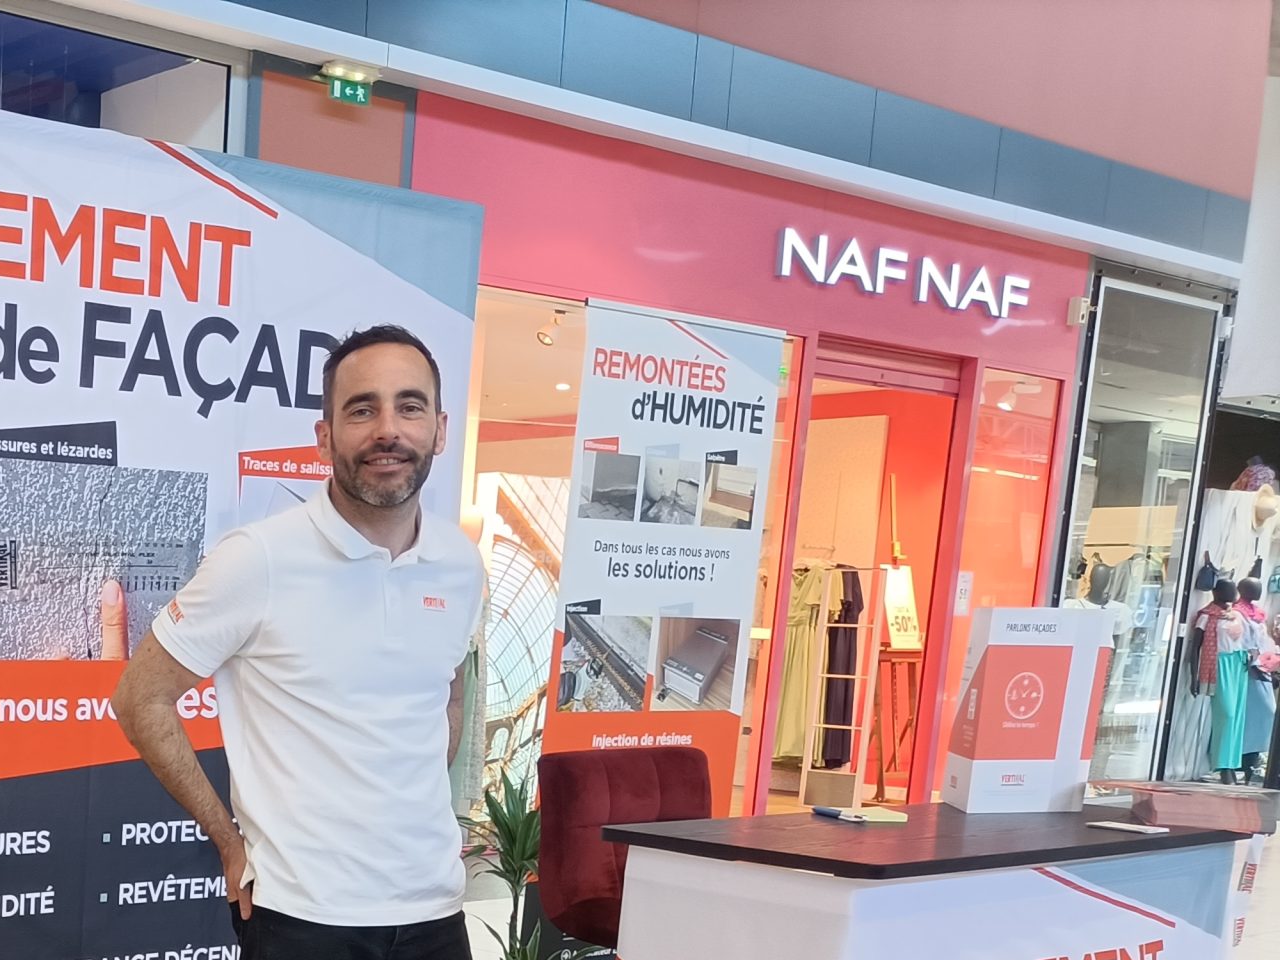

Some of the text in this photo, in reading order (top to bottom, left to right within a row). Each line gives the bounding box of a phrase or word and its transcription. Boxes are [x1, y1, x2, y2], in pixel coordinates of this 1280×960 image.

[778, 227, 1030, 318] NAF NAF
[79, 302, 341, 419] FAÇAD
[593, 347, 727, 393] REMONTÉES
[40, 440, 54, 457] et
[58, 439, 113, 461] lézardes
[242, 456, 280, 472] Traces
[282, 459, 297, 473] de
[594, 540, 730, 559] Dans tous les cas nous avons
[607, 557, 715, 582] les solutions !
[592, 733, 692, 749] Injection de résines
